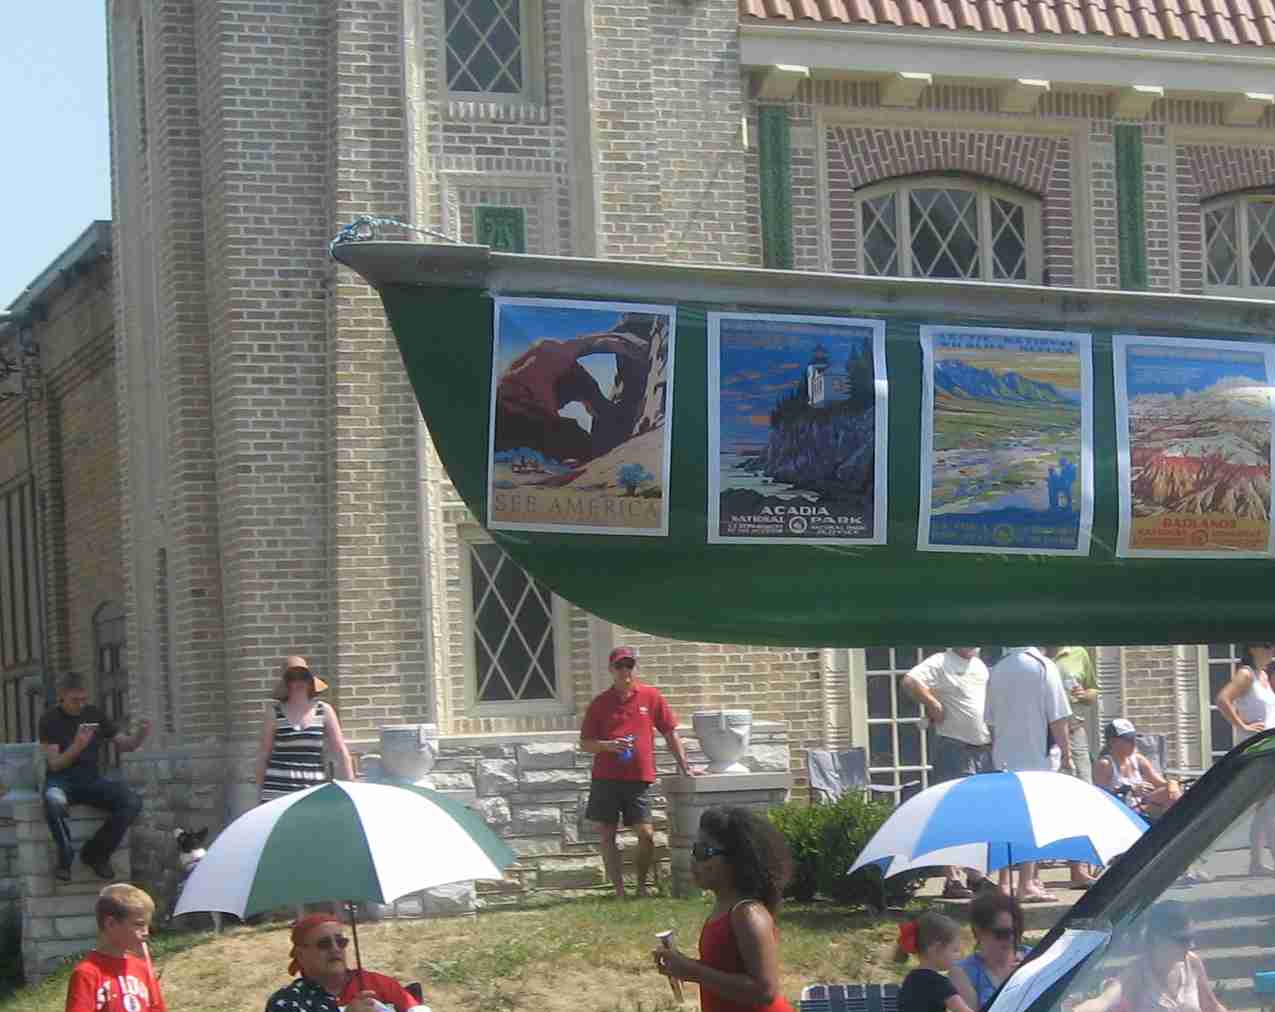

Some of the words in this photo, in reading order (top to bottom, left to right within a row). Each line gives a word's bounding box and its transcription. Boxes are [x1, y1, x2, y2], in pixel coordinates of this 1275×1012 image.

[496, 495, 536, 512] SEE
[552, 497, 656, 520] AMERICA
[760, 506, 830, 516] ACADIA
[731, 515, 785, 524] NATIONAL
[810, 516, 863, 525] PARK
